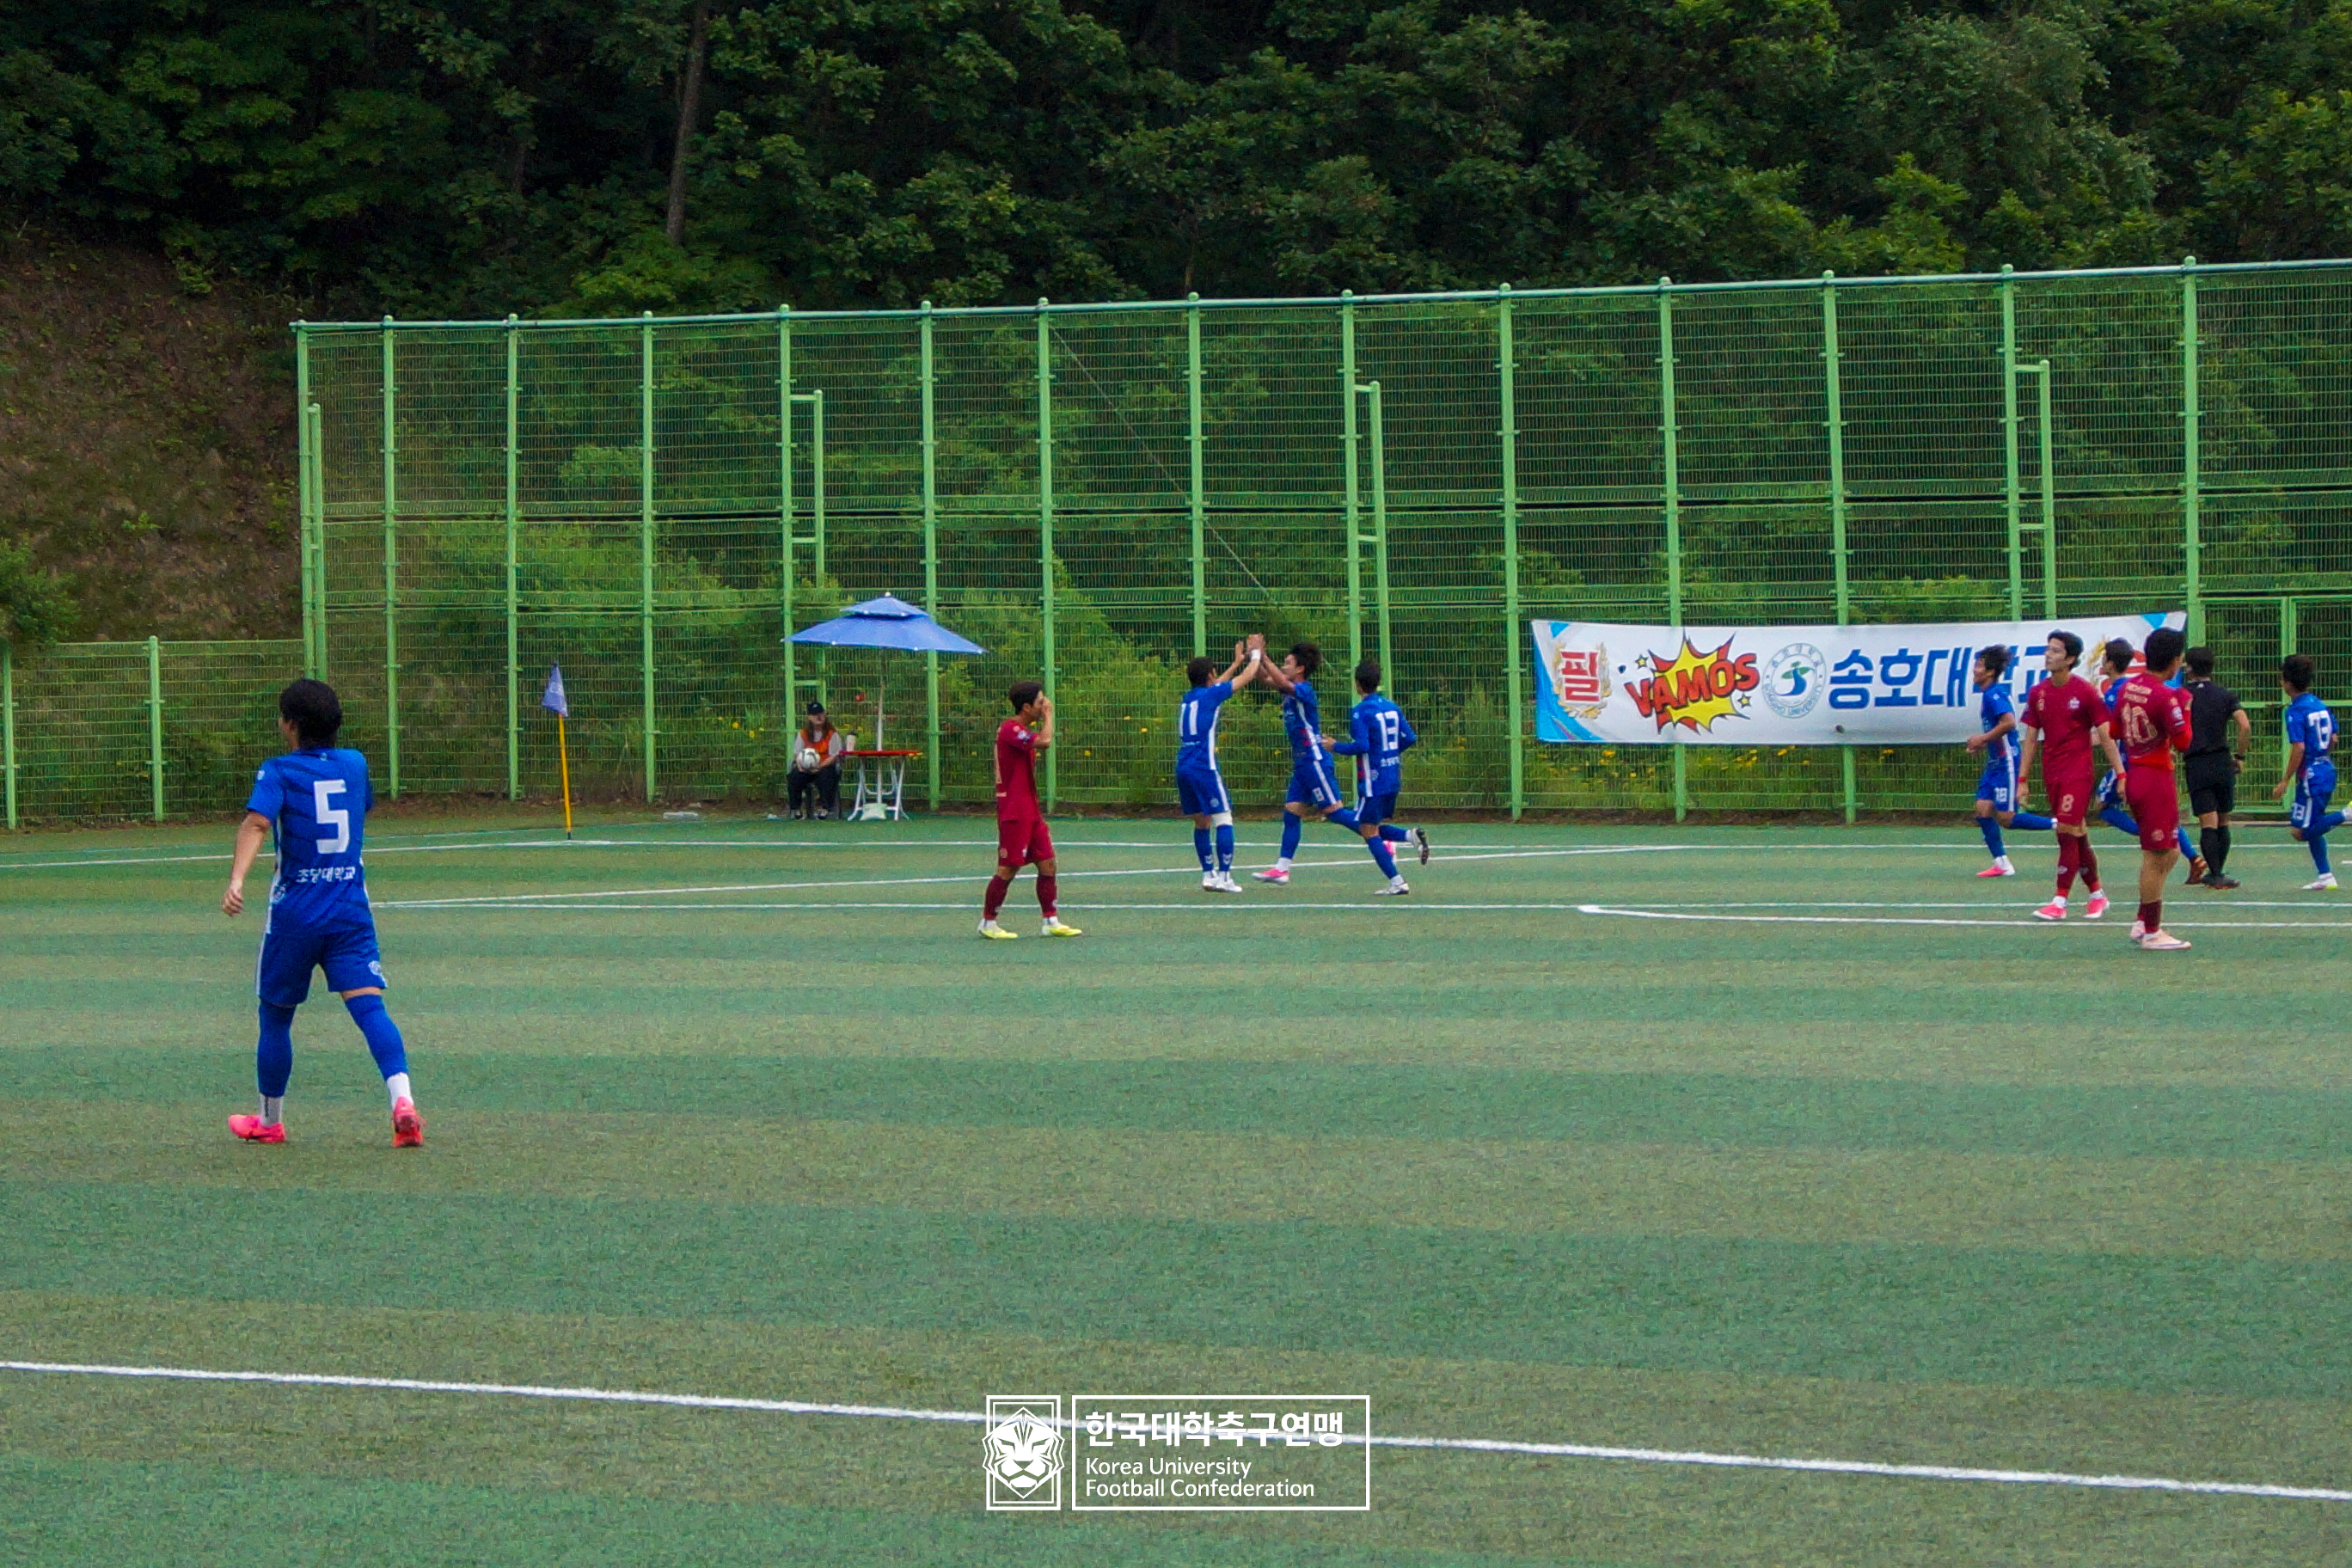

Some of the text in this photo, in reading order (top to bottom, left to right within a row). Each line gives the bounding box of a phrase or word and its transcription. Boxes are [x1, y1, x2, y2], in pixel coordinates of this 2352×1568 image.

[1559, 650, 1601, 703] 필
[1623, 652, 1761, 719] VAMOS
[1179, 700, 1199, 737] 11
[1375, 710, 1400, 751] 13
[2121, 701, 2159, 747] 10
[313, 778, 351, 854] 5
